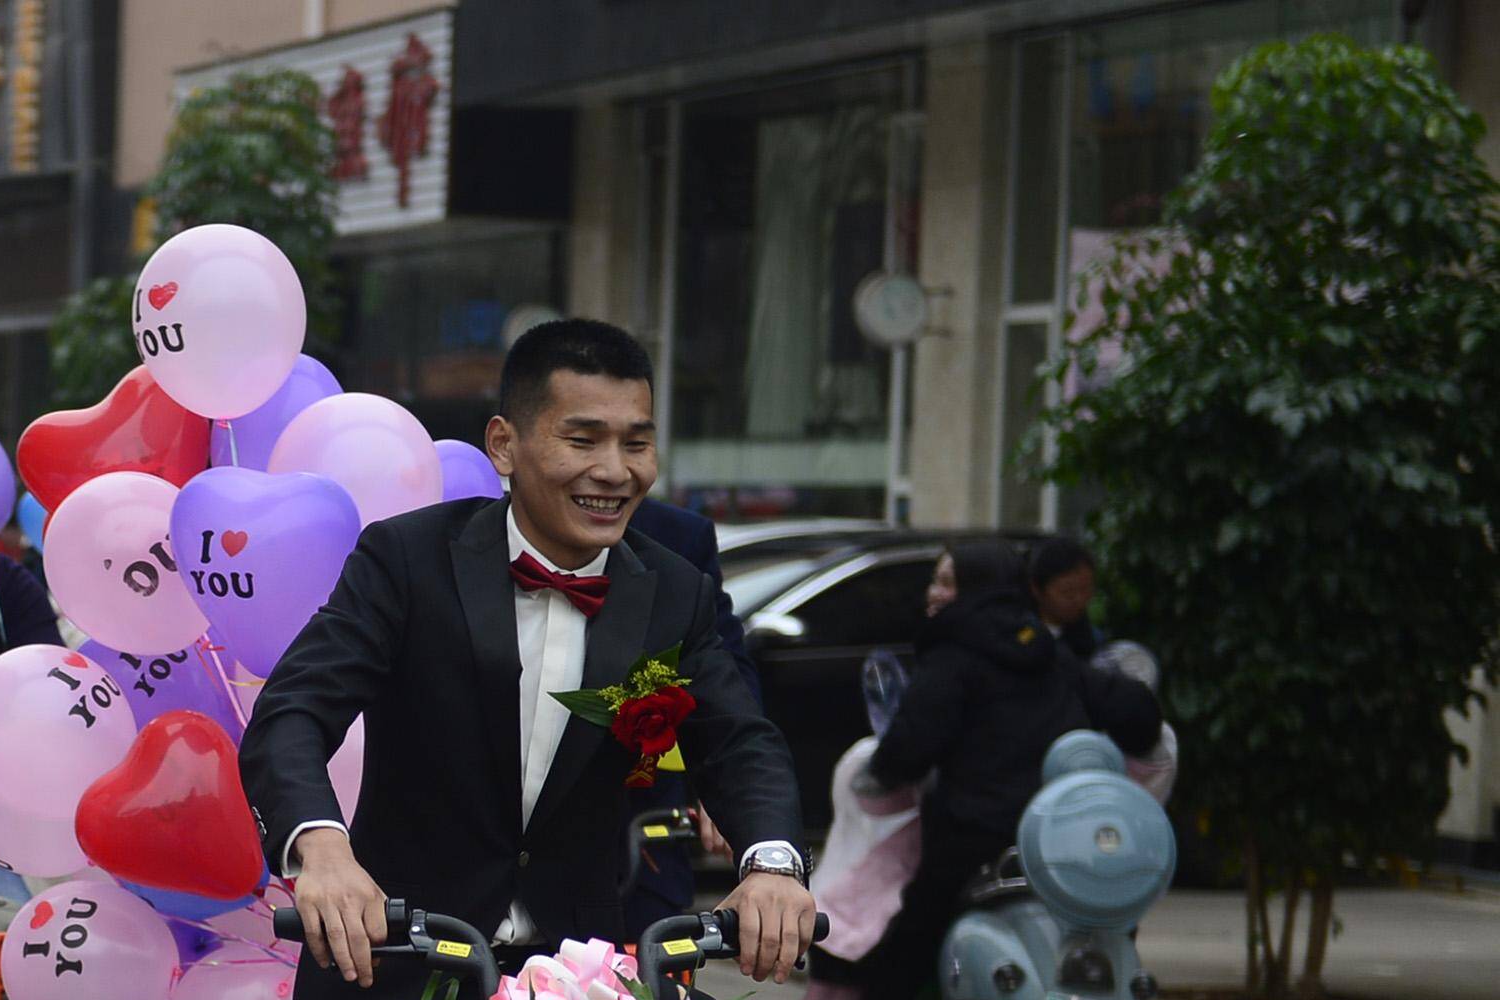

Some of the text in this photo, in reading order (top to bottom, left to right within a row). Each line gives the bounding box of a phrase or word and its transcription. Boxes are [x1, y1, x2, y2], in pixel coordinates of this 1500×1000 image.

[137, 323, 185, 361] OU
[200, 530, 214, 564] I
[190, 570, 254, 599] YOU
[47, 667, 81, 691] I
[68, 674, 121, 729] YOU
[23, 940, 50, 958] I
[55, 897, 98, 978] YOU
